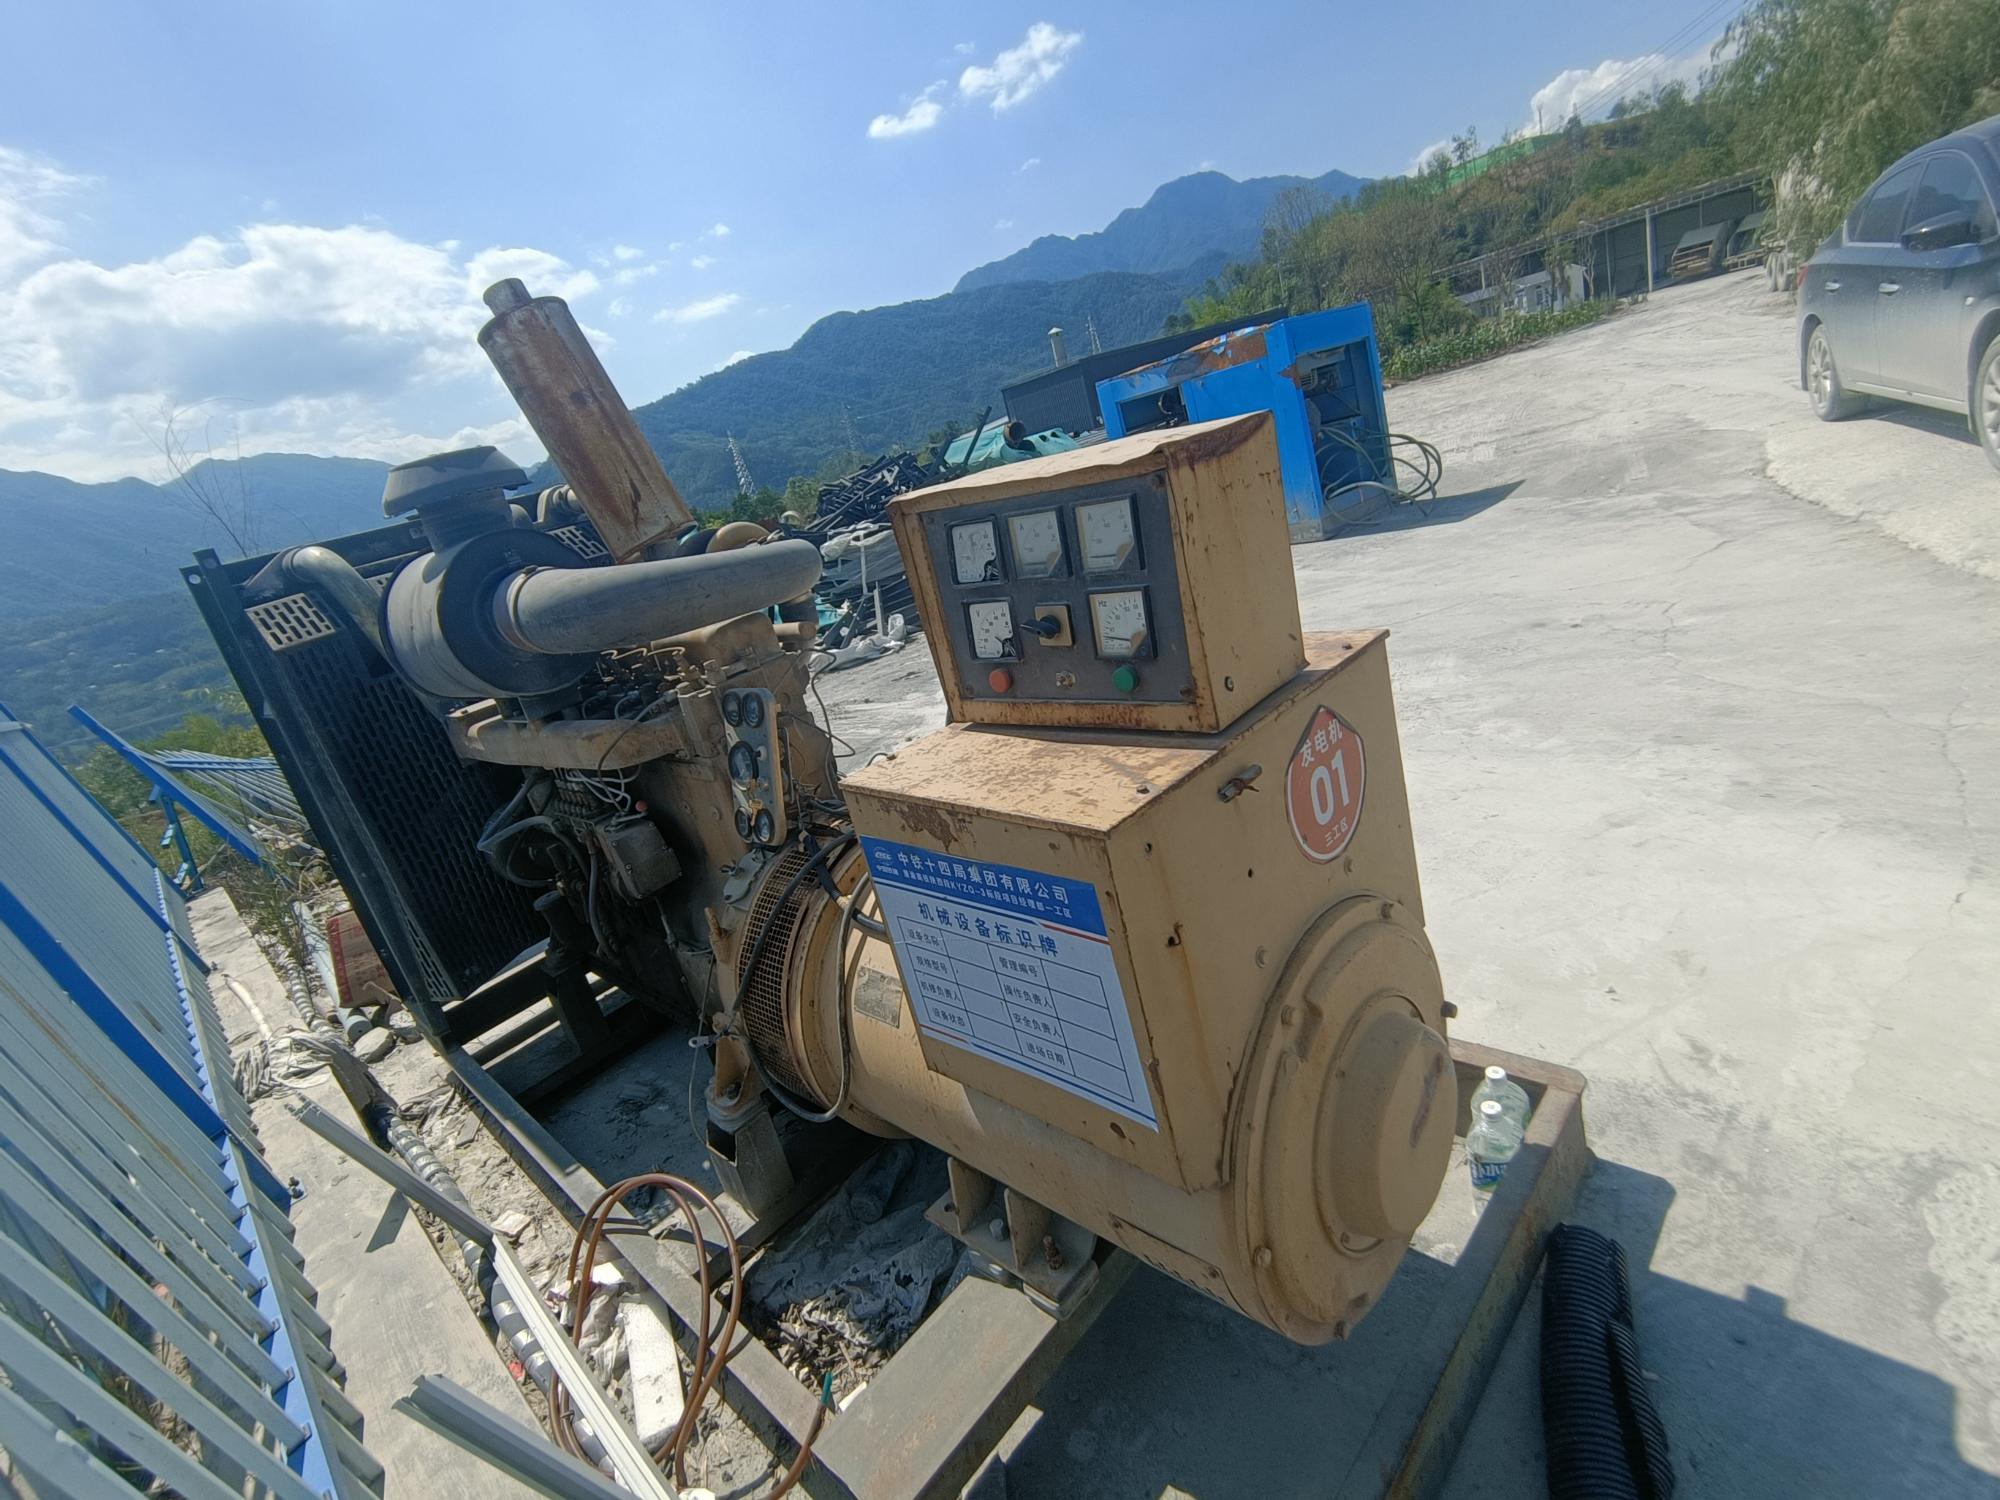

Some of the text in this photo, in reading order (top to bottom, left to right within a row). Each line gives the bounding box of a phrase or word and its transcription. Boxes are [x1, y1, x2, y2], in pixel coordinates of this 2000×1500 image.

[1300, 719, 1343, 767] 发电机
[1310, 749, 1350, 826] 01
[897, 851, 1069, 905] 中铁十四局集团有限公司
[918, 901, 1058, 957] 机械设备标识牌
[916, 955, 948, 974] 规格型号
[999, 956, 1038, 977] 管理编号
[1003, 983, 1053, 1010] 操作负责人
[1012, 1012, 1062, 1038] 安全负责人
[1025, 1041, 1066, 1065] 进场日期
